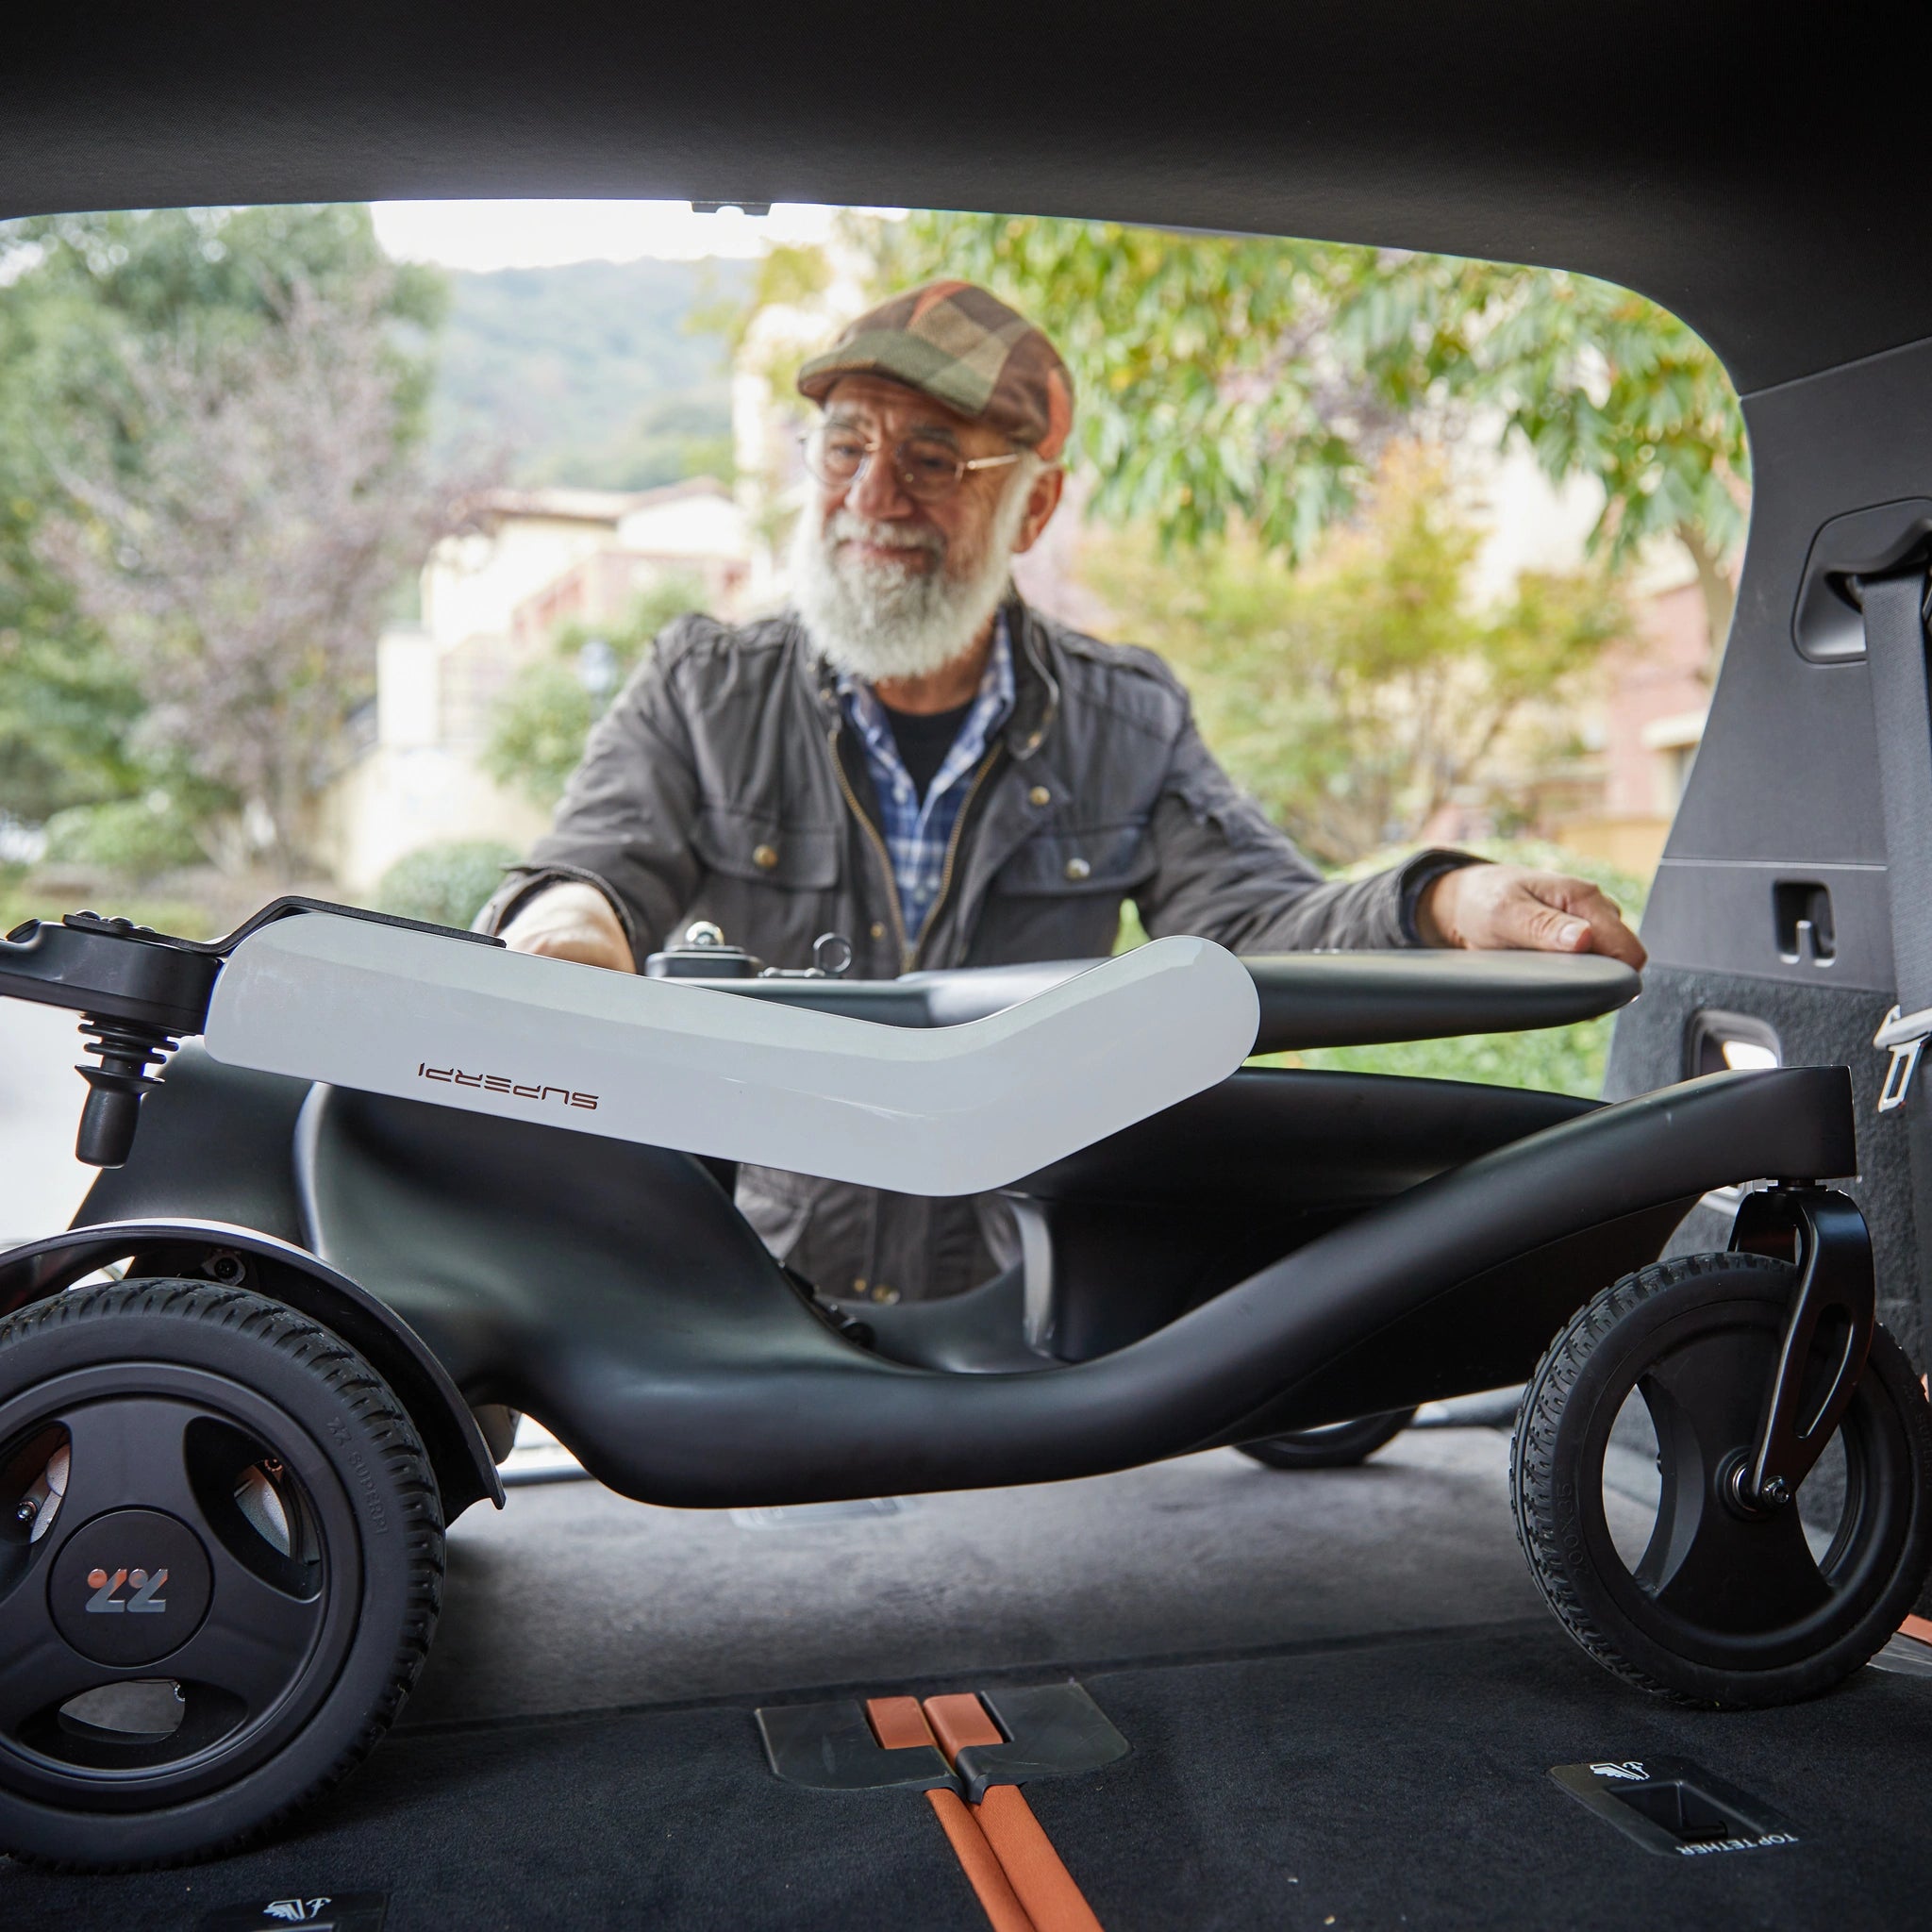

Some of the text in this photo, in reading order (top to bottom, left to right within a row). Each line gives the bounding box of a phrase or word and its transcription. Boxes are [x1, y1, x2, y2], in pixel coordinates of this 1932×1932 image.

[417, 1062, 599, 1110] SUPERPI
[348, 1451, 389, 1535] SUPERPI
[1675, 1833, 1799, 1856] TOP TETHER
